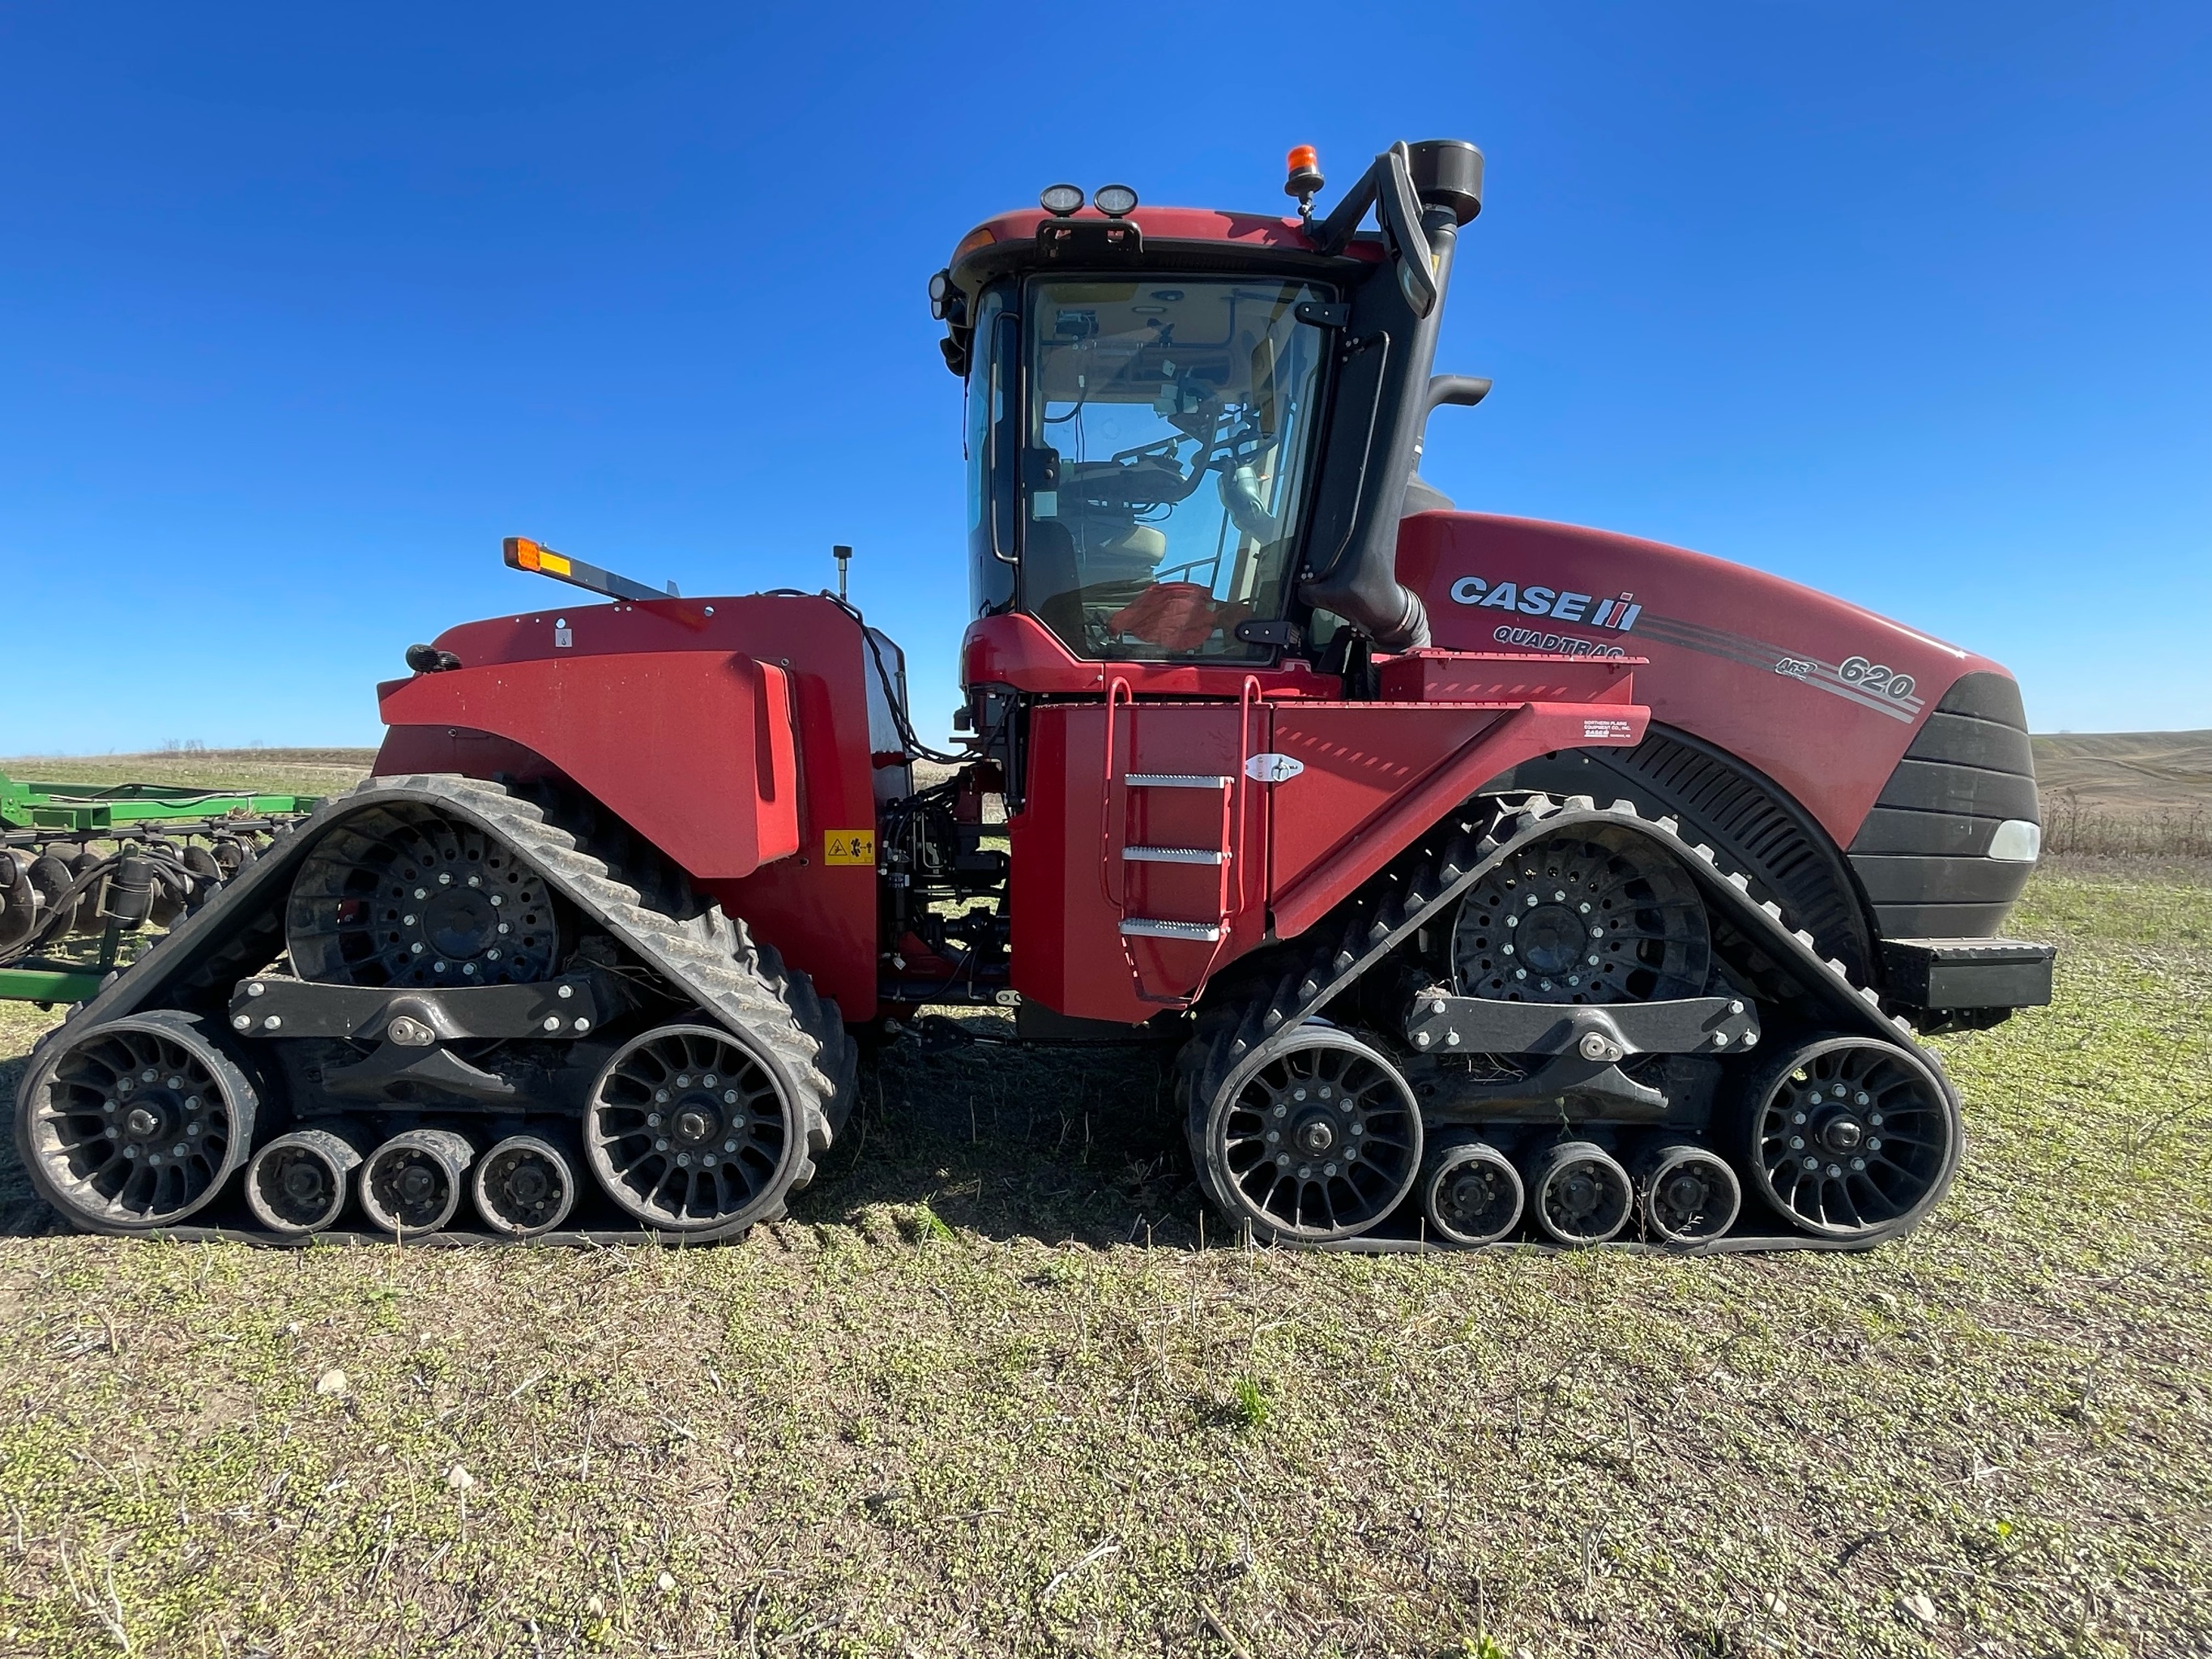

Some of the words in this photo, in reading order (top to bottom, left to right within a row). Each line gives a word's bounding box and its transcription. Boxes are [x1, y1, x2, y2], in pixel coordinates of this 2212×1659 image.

[1450, 576, 1591, 621] CASE
[1775, 657, 1815, 677] AFS
[1838, 655, 1915, 700] 620
